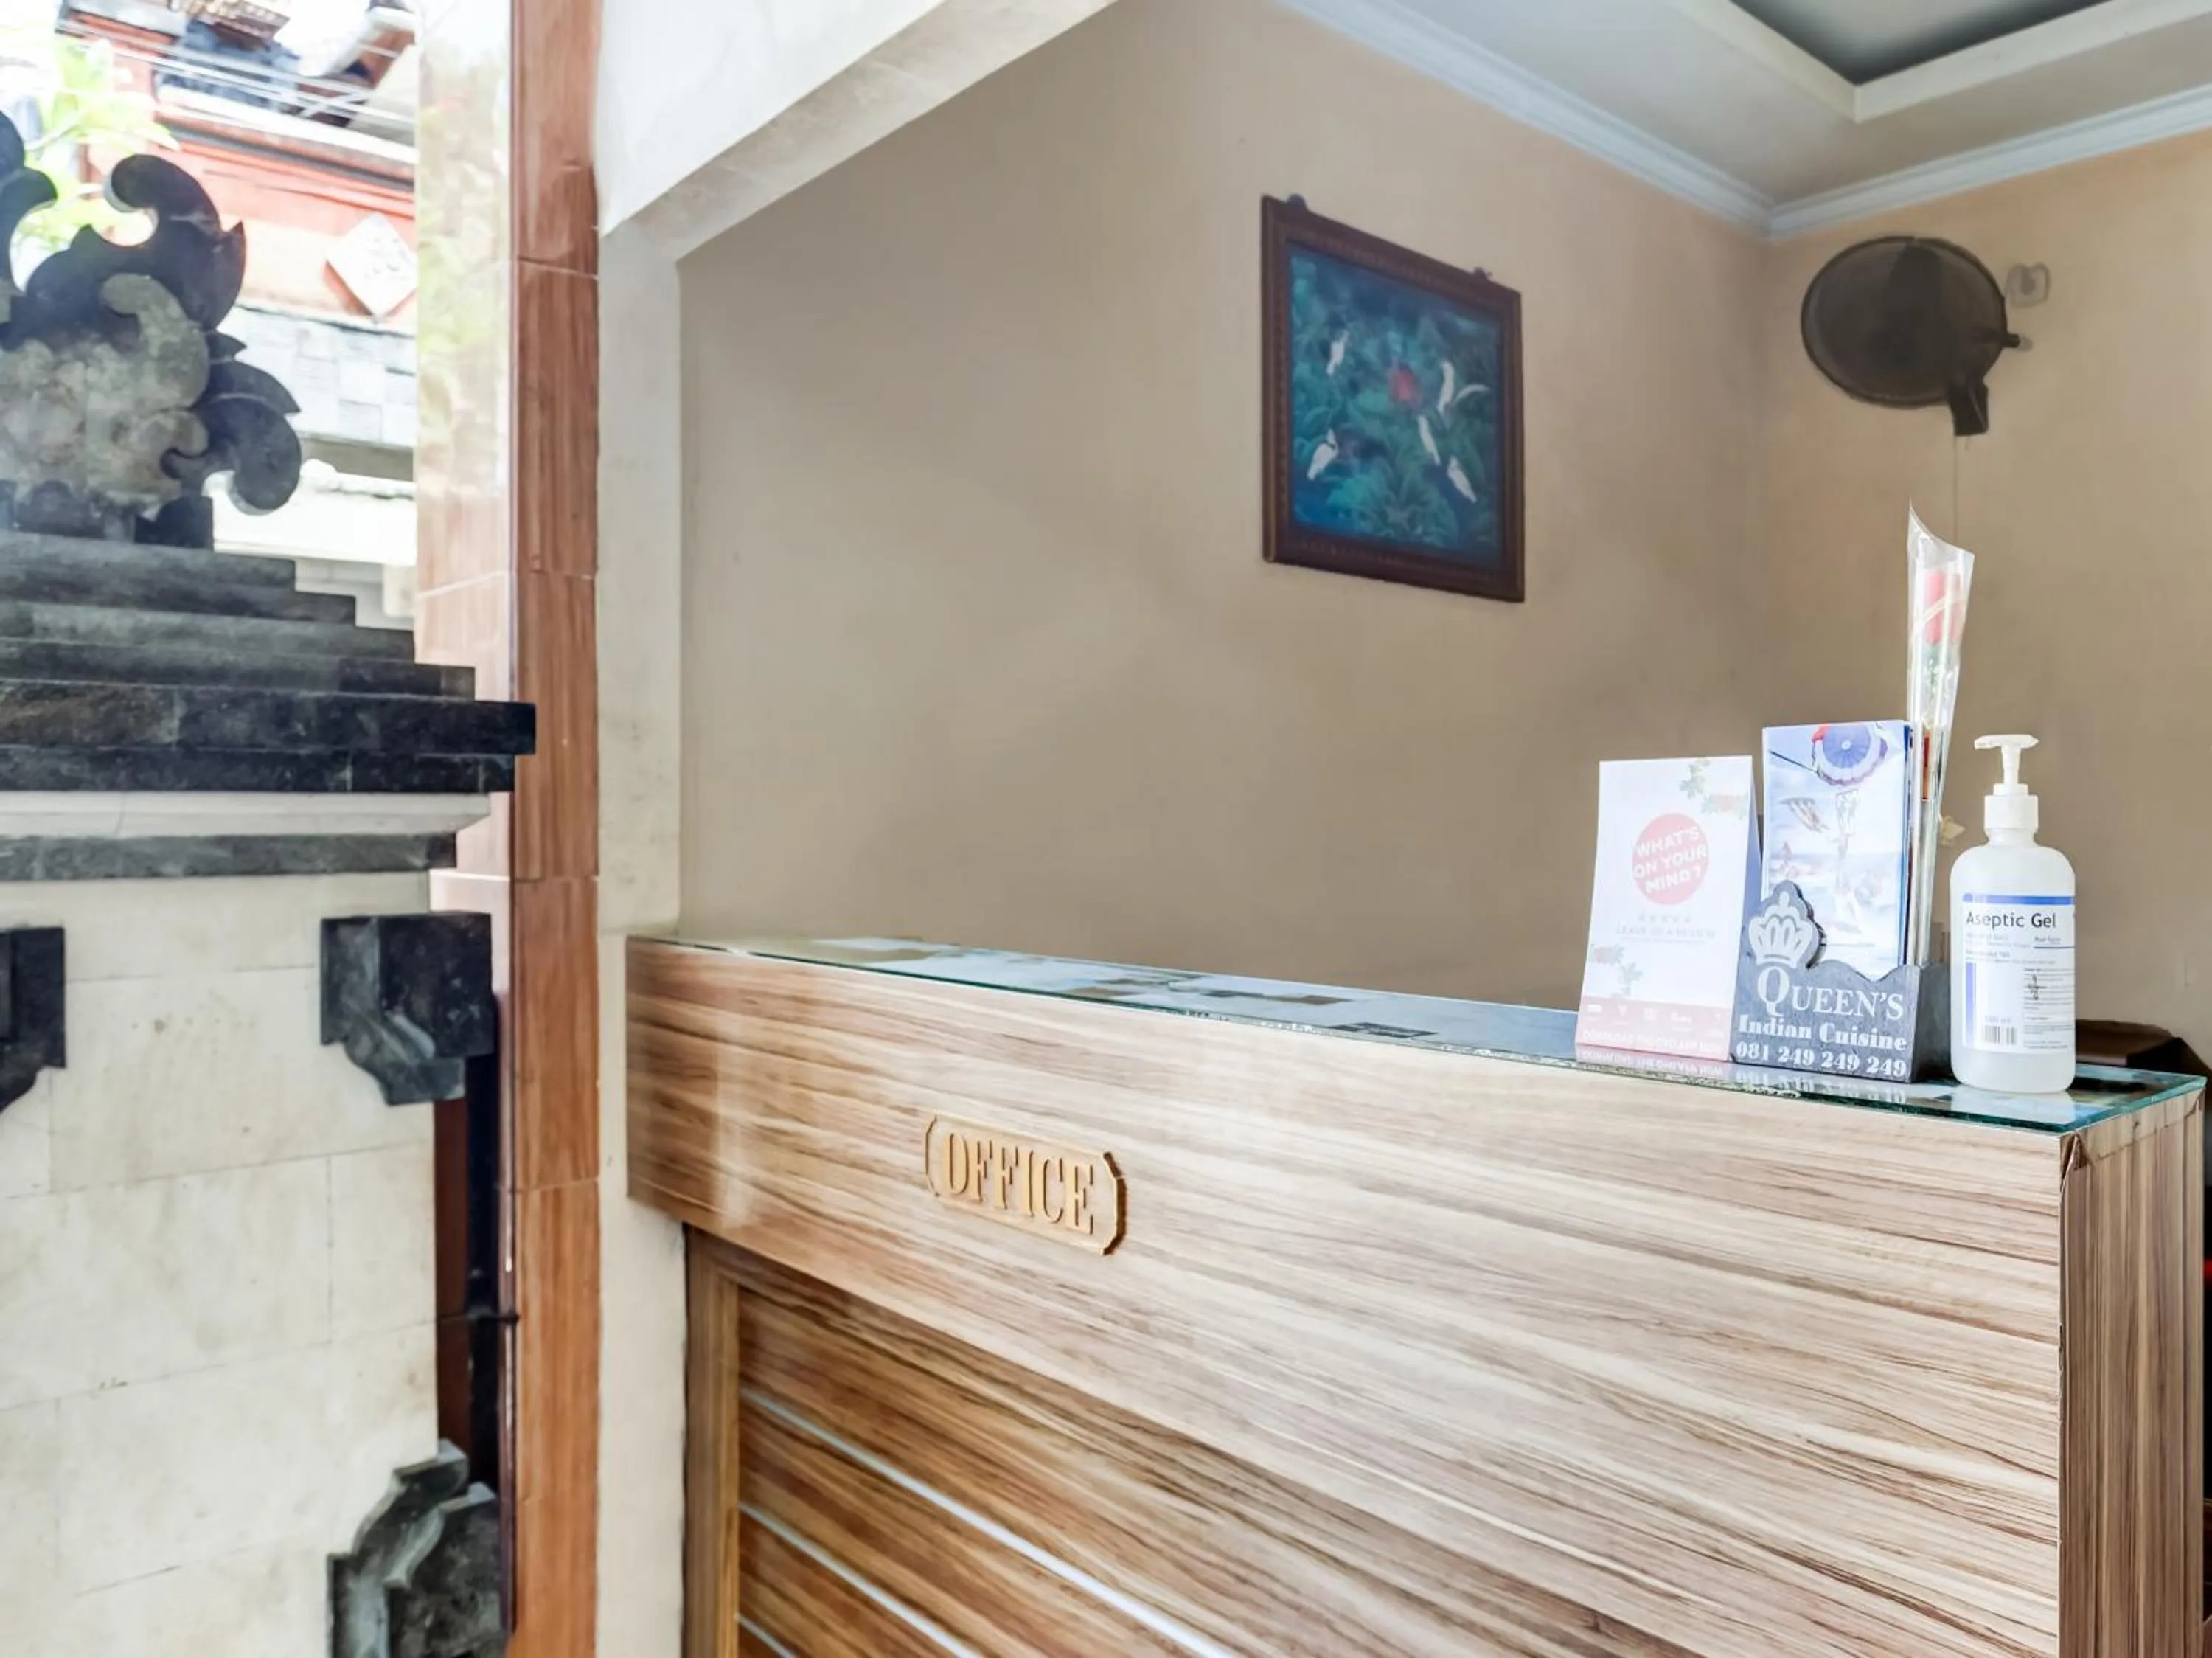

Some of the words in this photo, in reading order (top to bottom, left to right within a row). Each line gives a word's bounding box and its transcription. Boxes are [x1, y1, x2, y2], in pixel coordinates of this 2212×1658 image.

[1634, 861, 1657, 878] ON
[1660, 844, 1707, 870] YOUR
[1966, 912, 2025, 930] Aseptic
[2031, 912, 2056, 928] Gel
[1756, 965, 1904, 1021] QUEEN'S
[1738, 1014, 1812, 1039] Indian
[1819, 1022, 1907, 1051] Cuisine
[1736, 1041, 1769, 1058] 081
[1778, 1048, 1815, 1066] 249
[1820, 1051, 1860, 1072] 249
[1866, 1056, 1907, 1078] 249
[942, 1131, 1094, 1235] OFFICE
